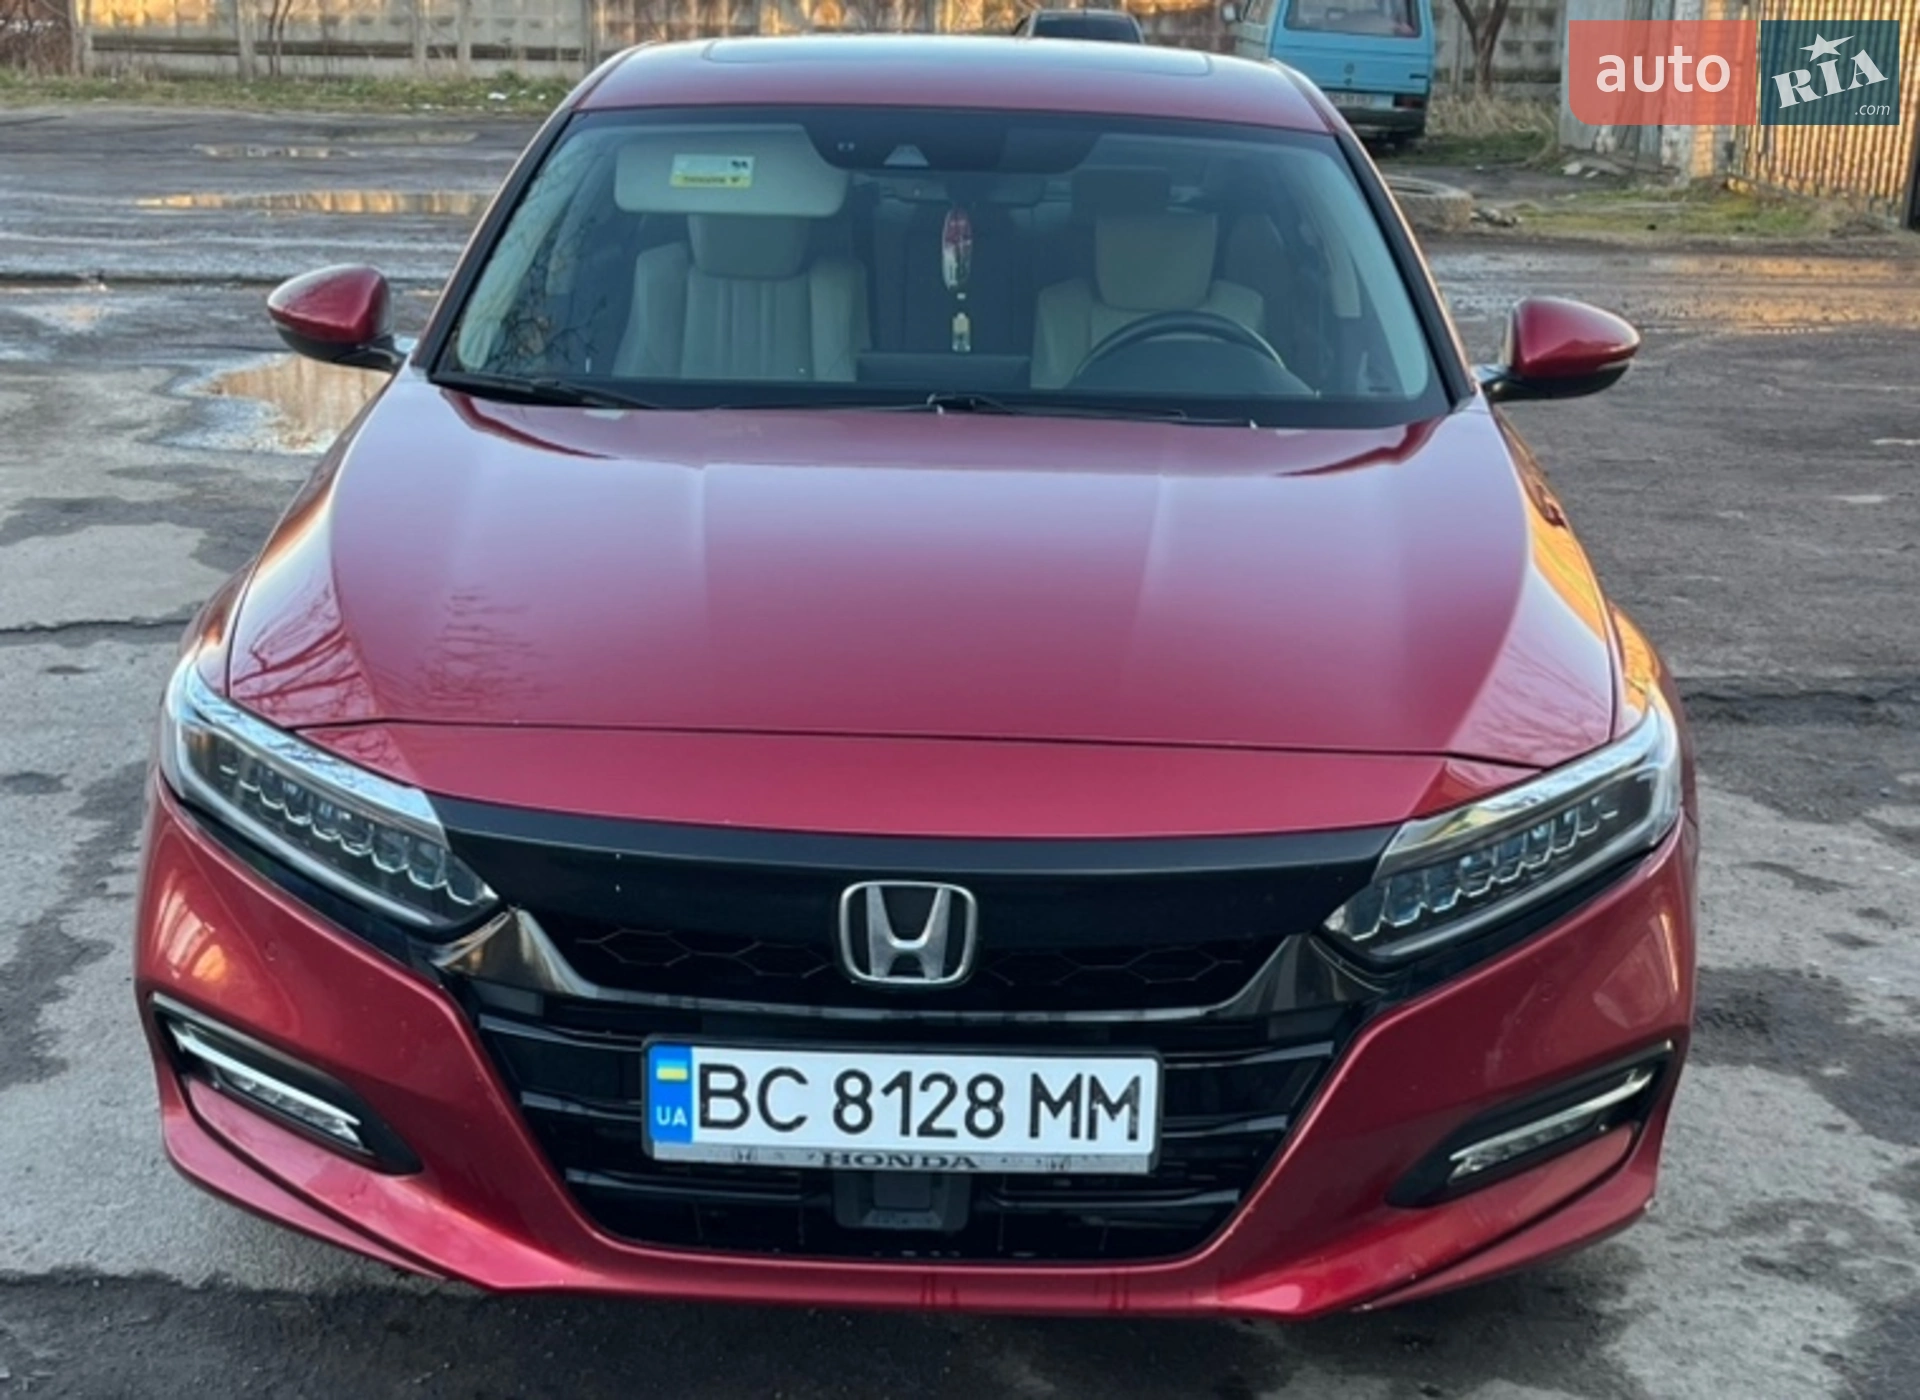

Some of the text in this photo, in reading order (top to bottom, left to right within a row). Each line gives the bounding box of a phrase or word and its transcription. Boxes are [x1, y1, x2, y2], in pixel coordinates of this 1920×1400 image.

[698, 1063, 1141, 1141] BC 8128 MM
[656, 1106, 688, 1127] UA
[822, 1151, 979, 1170] HONDA
